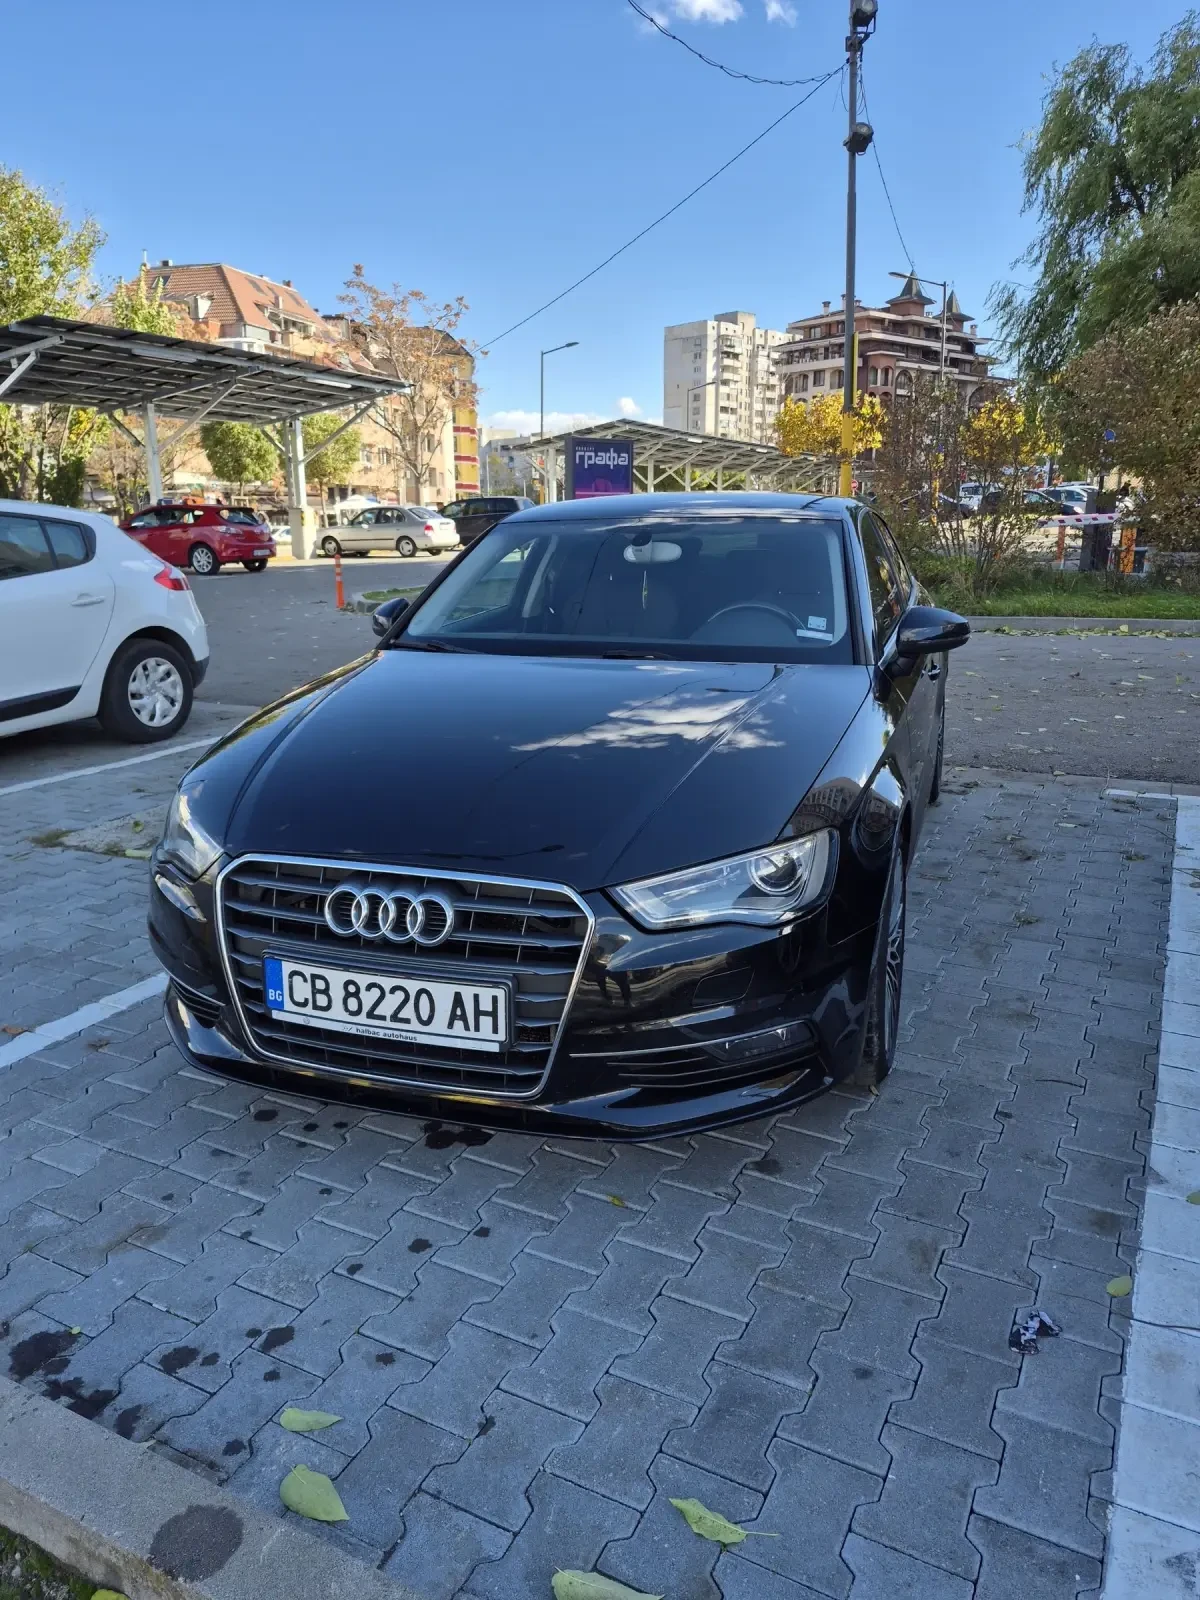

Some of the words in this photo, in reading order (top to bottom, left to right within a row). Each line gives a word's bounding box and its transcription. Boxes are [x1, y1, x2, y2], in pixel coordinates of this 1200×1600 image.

[576, 448, 628, 469] графа
[268, 989, 283, 1001] BG
[288, 969, 333, 1012] CB
[342, 979, 436, 1027] 8220
[447, 991, 499, 1034] AH
[383, 1032, 418, 1042] autohaus
